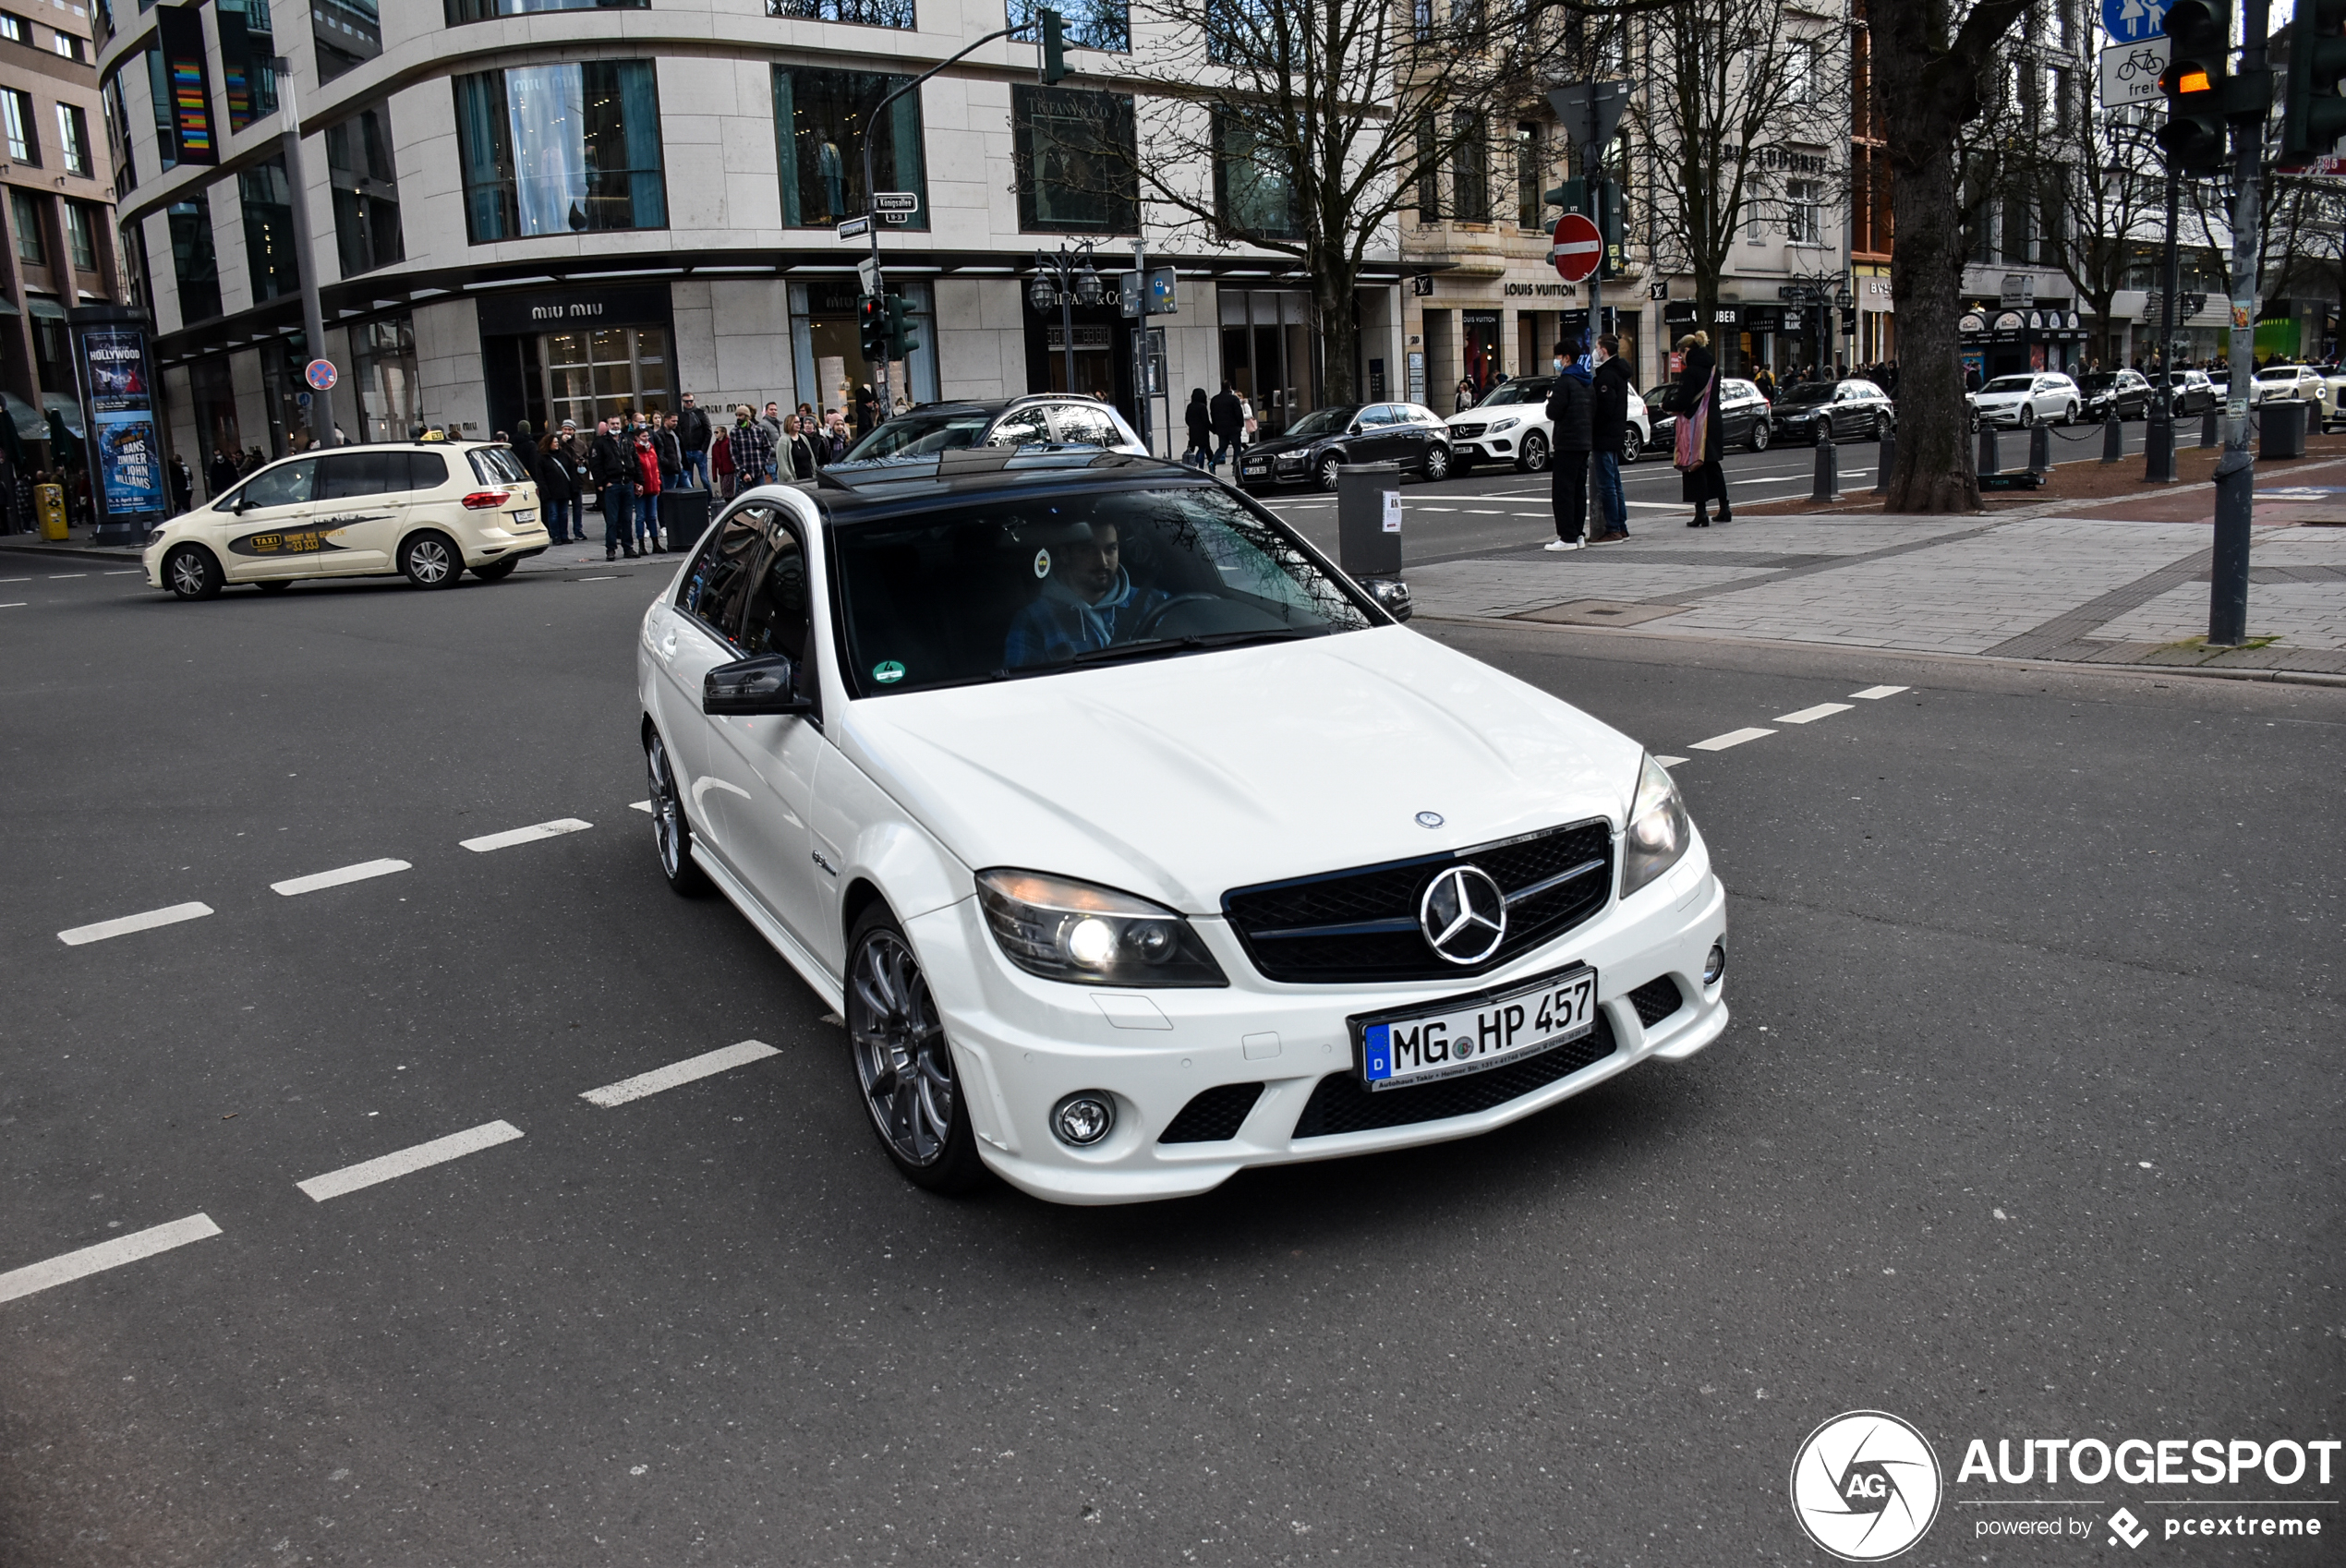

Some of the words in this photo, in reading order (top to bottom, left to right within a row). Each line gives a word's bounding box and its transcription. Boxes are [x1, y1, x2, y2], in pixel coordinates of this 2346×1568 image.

[2128, 79, 2154, 96] frei
[1505, 283, 1533, 296] LOUIS
[1535, 283, 1577, 297] VUITTON
[1411, 336, 1420, 344] 20
[90, 349, 140, 361] HOLLYWOOD
[123, 440, 146, 454] HANS
[116, 452, 148, 465] ZIMMER
[127, 464, 149, 477] JOHN
[115, 474, 151, 490] WILLIAMS
[255, 536, 277, 546] TAXI
[305, 532, 318, 541] WIE
[292, 541, 302, 552] 33
[304, 538, 320, 550] 333
[884, 660, 894, 672] 4
[1393, 1021, 1449, 1070] MG
[1478, 1004, 1525, 1054] HP
[1534, 979, 1591, 1034] 457
[1373, 1058, 1384, 1071] D
[1379, 1077, 1414, 1089] Autohaus
[1416, 1074, 1434, 1082] Takir
